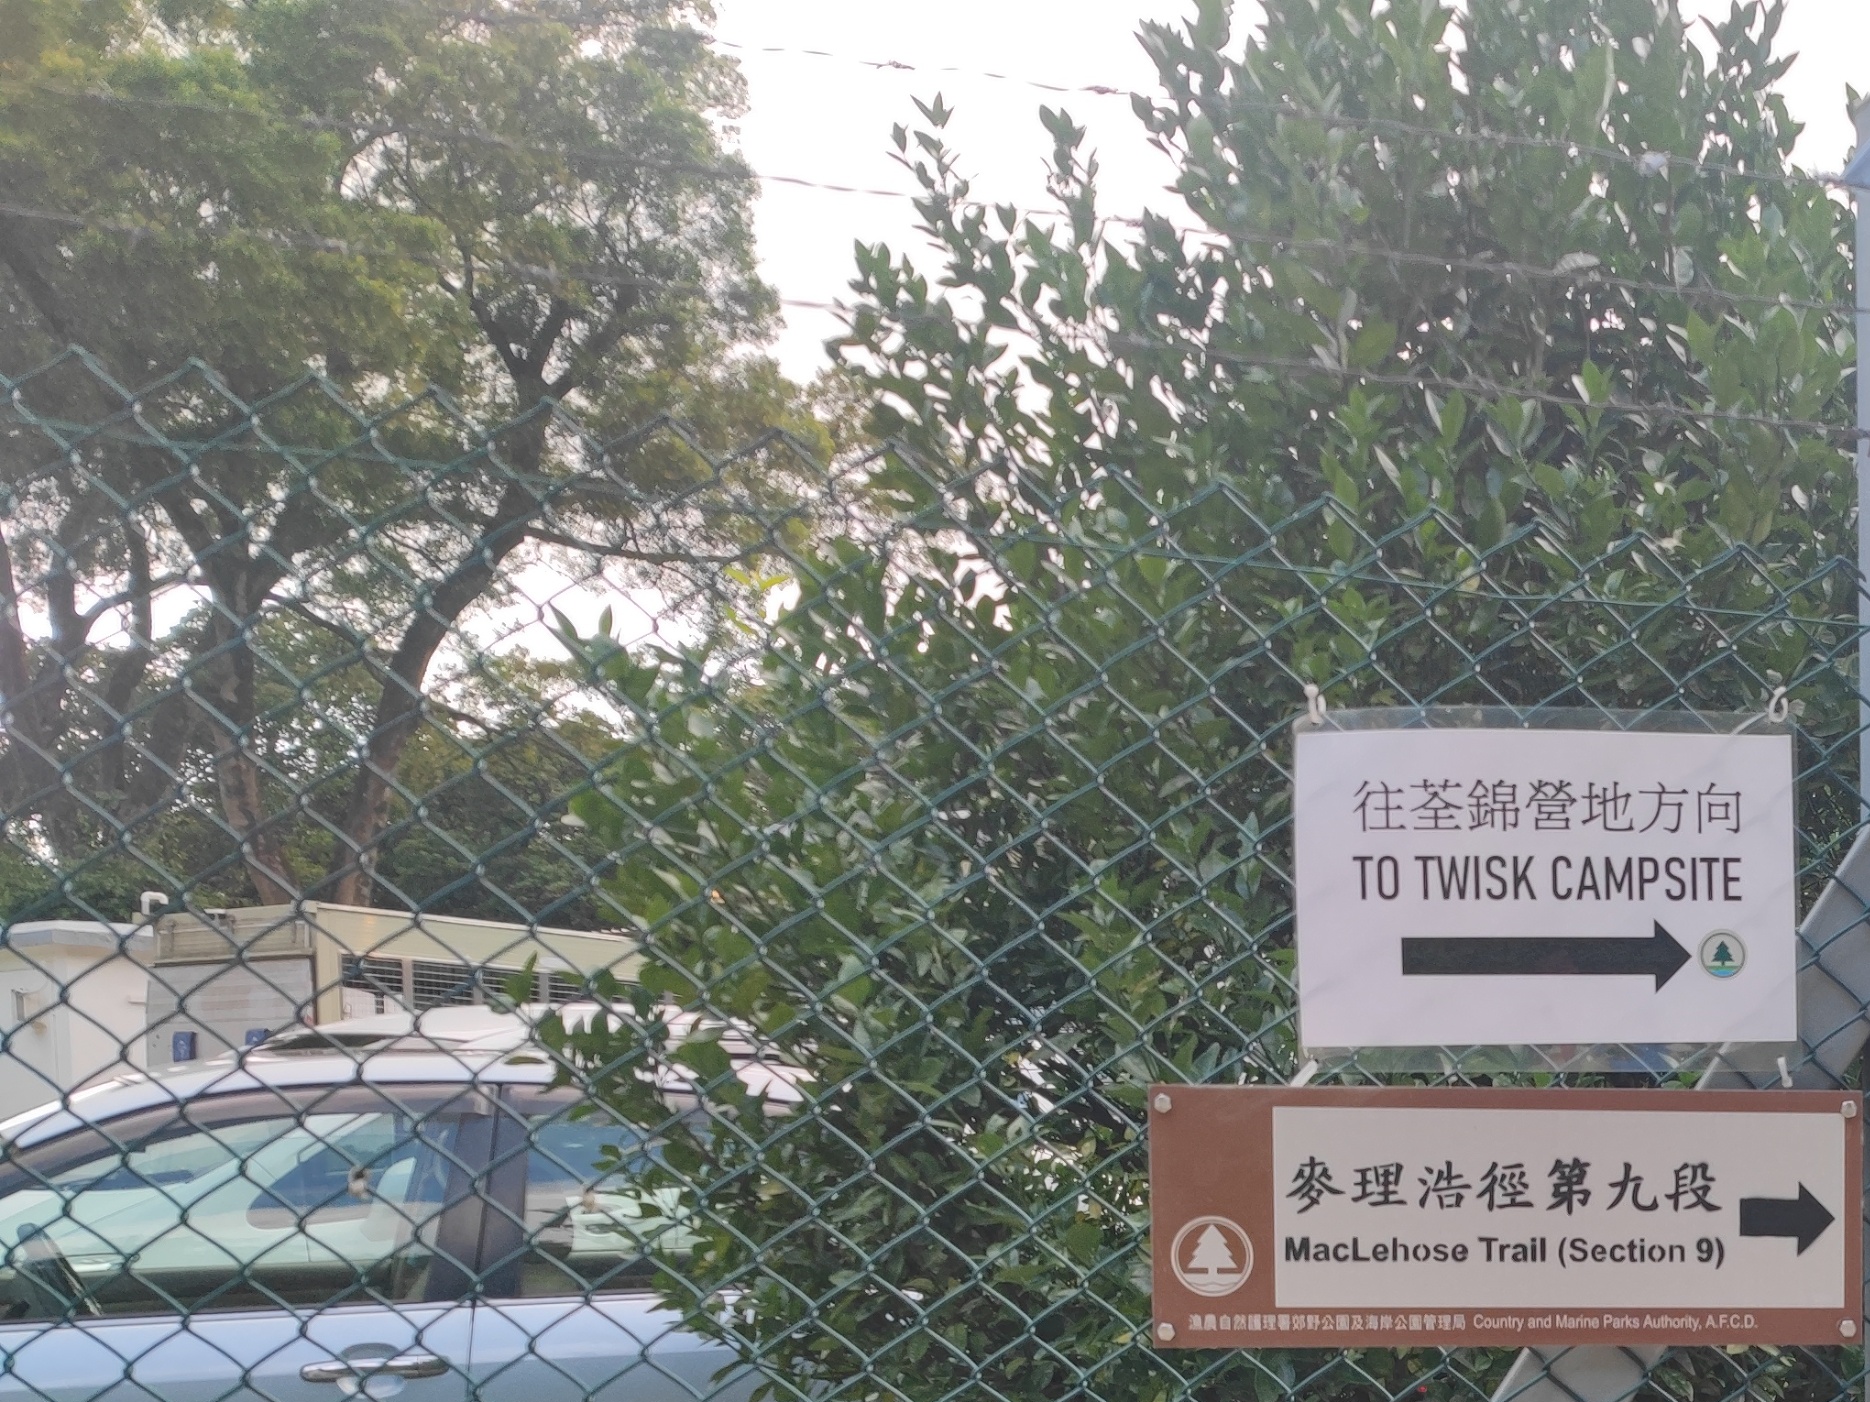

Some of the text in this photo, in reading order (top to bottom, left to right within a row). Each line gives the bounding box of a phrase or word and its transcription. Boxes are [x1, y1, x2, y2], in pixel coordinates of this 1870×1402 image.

[1352, 779, 1742, 835] 往荃錦營地方向
[1352, 855, 1743, 902] TO TWISK CAMPSITE
[1284, 1156, 1723, 1215] 麥理浩徑第九段
[1284, 1236, 1725, 1270] MacLehose Trail (Section 9)
[1472, 1313, 1759, 1332] Country and Marine Parks Authority, A.F.C.D.
